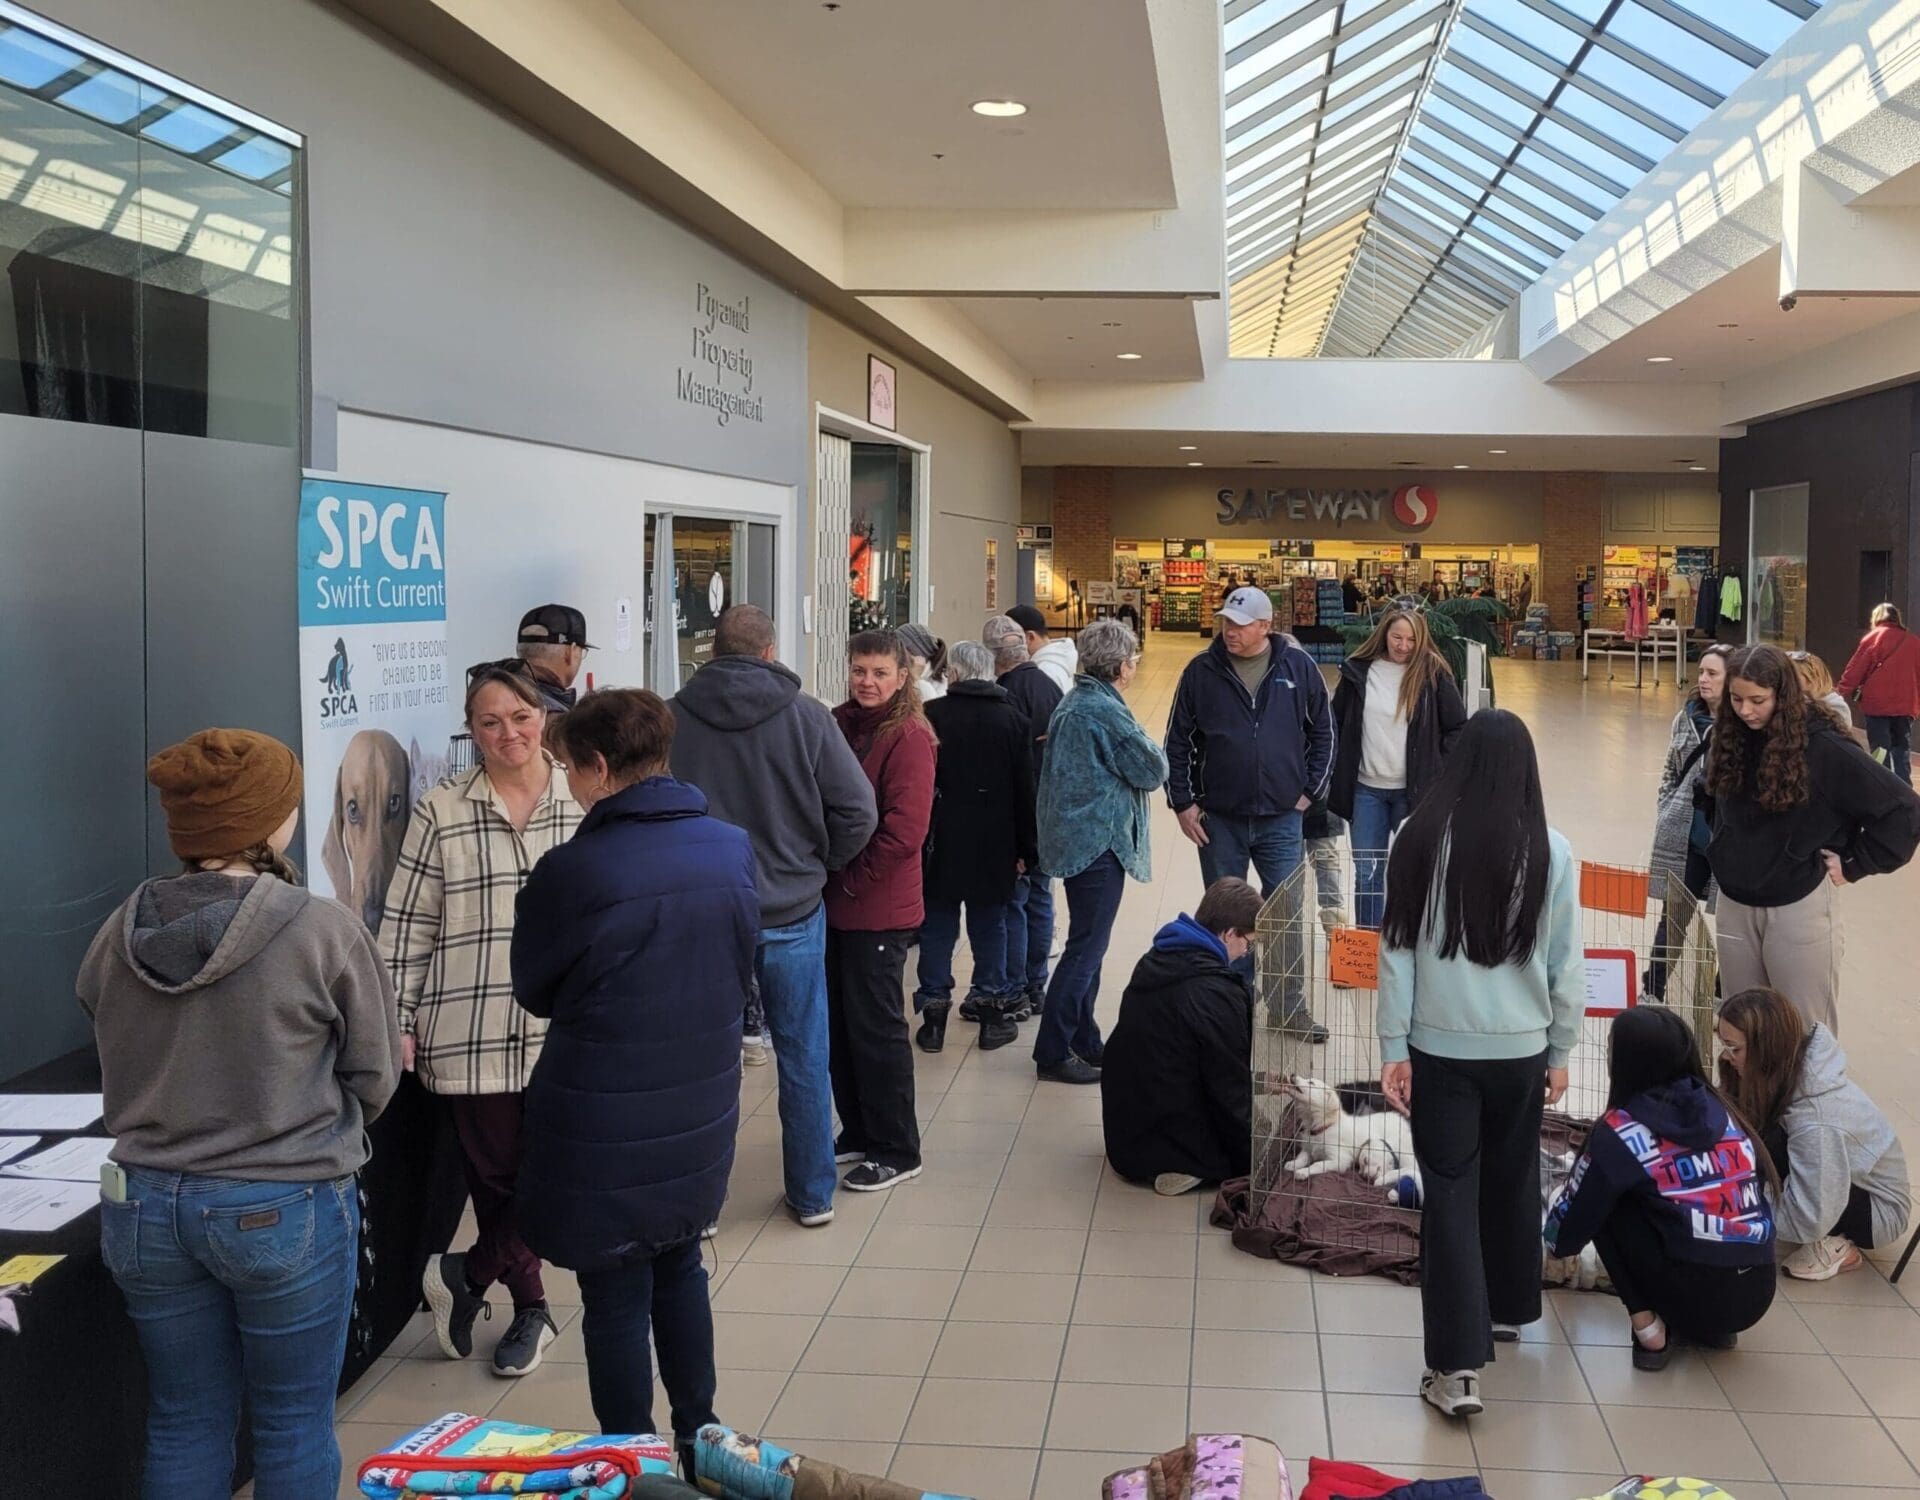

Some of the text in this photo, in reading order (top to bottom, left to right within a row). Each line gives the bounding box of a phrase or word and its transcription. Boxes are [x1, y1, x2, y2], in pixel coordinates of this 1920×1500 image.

[696, 282, 750, 334] Pyramid
[692, 326, 753, 395] Property
[677, 367, 763, 427] Management
[1216, 488, 1386, 523] SAFEWAY
[316, 496, 443, 570] SPCA
[316, 575, 445, 609] Swift Current
[320, 694, 358, 718] SPCA
[1336, 933, 1371, 948] Please
[1339, 956, 1376, 970] Before
[1659, 1148, 1741, 1185] TOMMY
